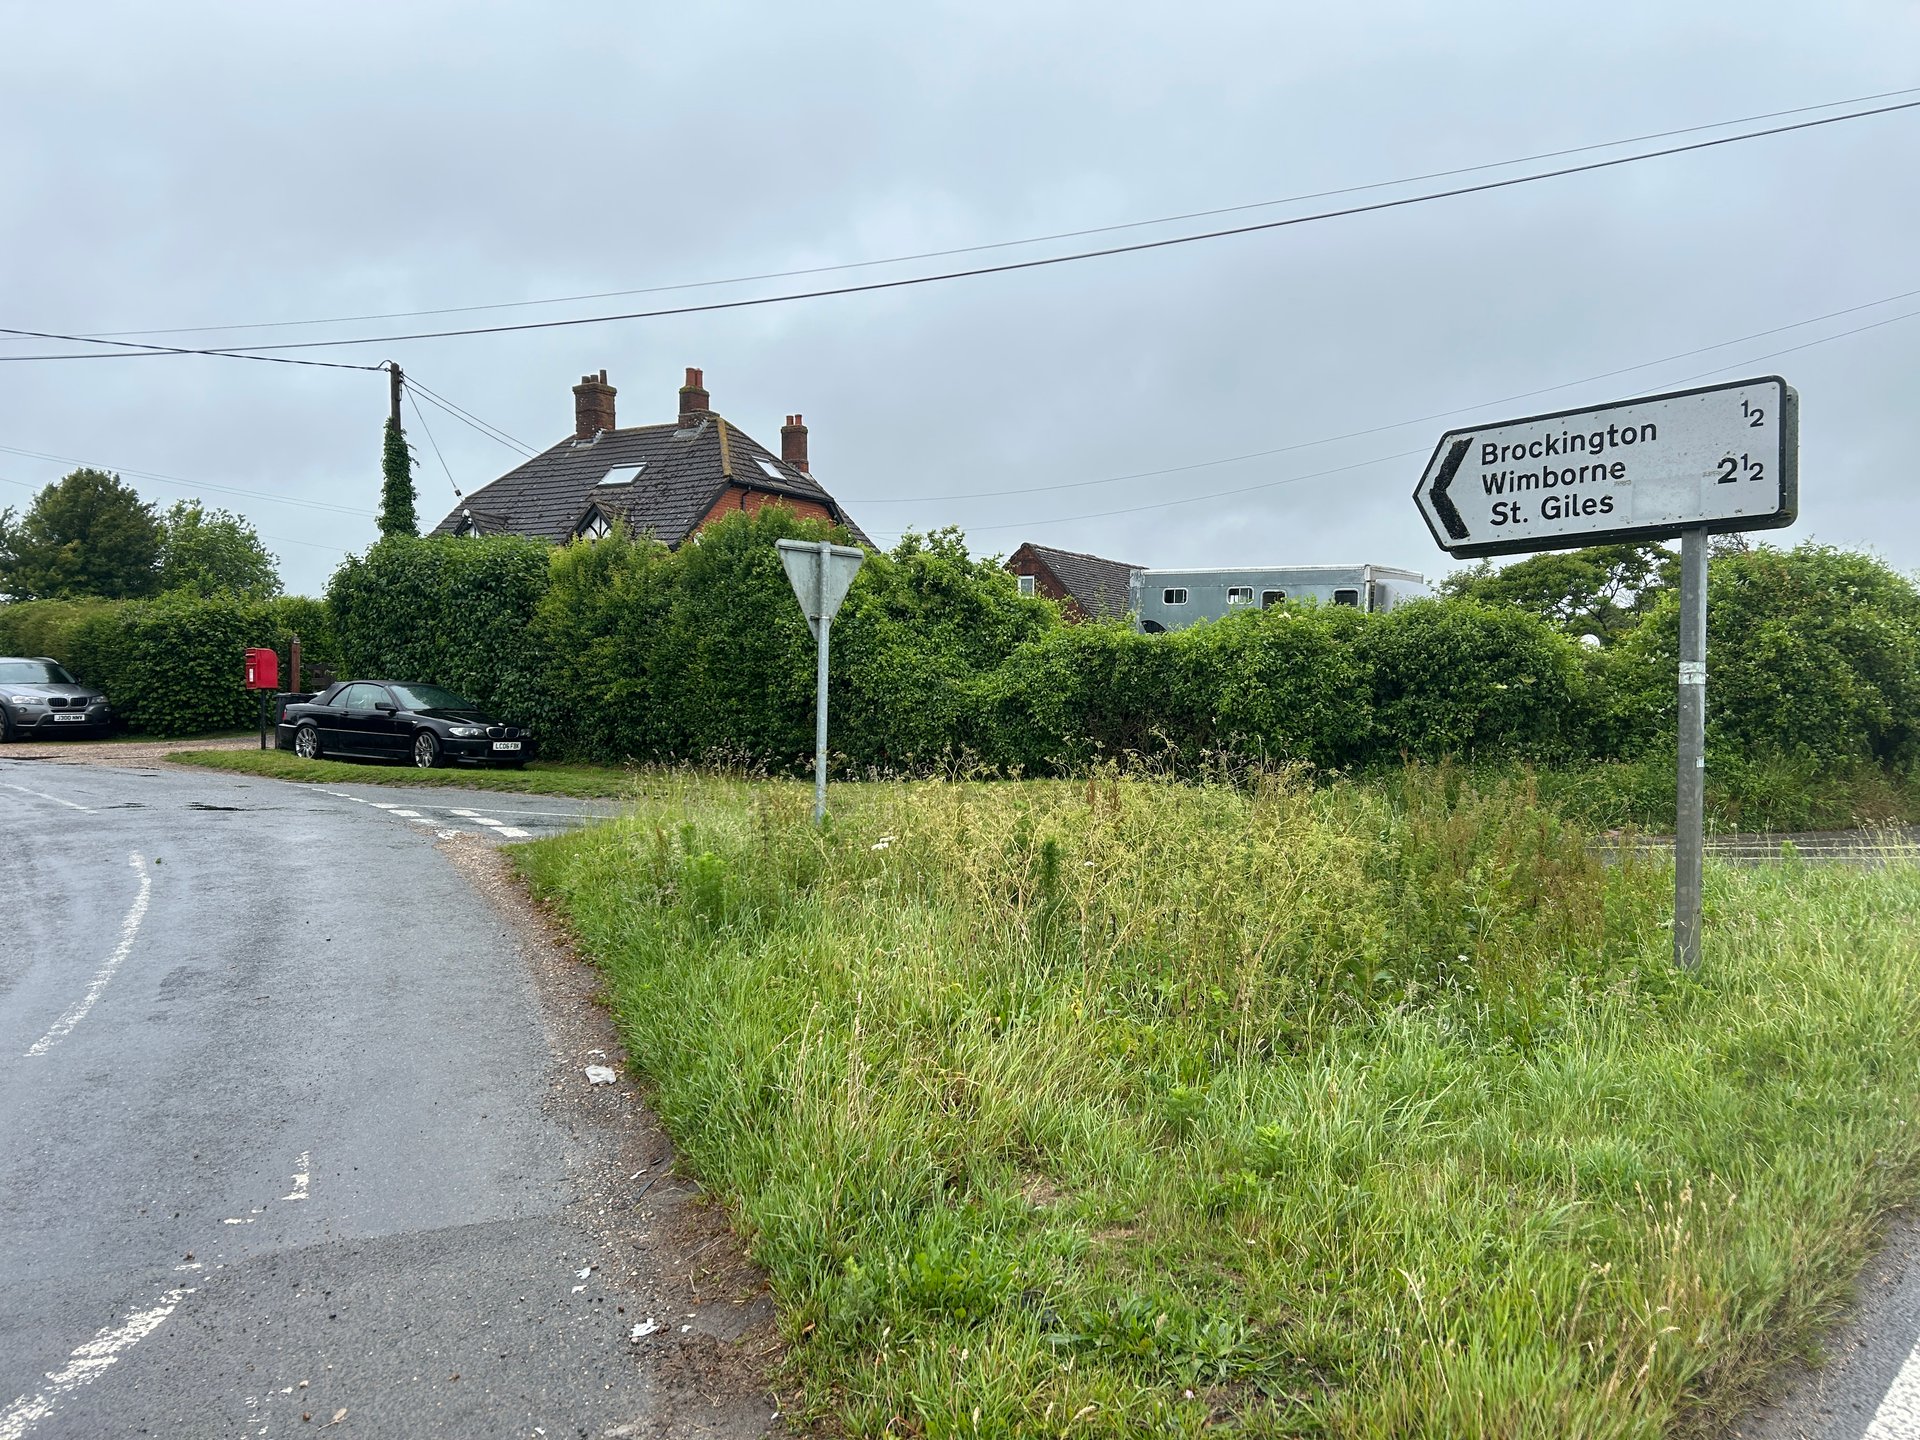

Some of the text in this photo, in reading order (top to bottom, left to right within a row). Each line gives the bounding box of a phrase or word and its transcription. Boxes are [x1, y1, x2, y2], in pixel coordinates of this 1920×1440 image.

[1481, 423, 1657, 466] Brockington
[1482, 461, 1626, 496] Wimborne
[1490, 493, 1614, 526] St. Giles
